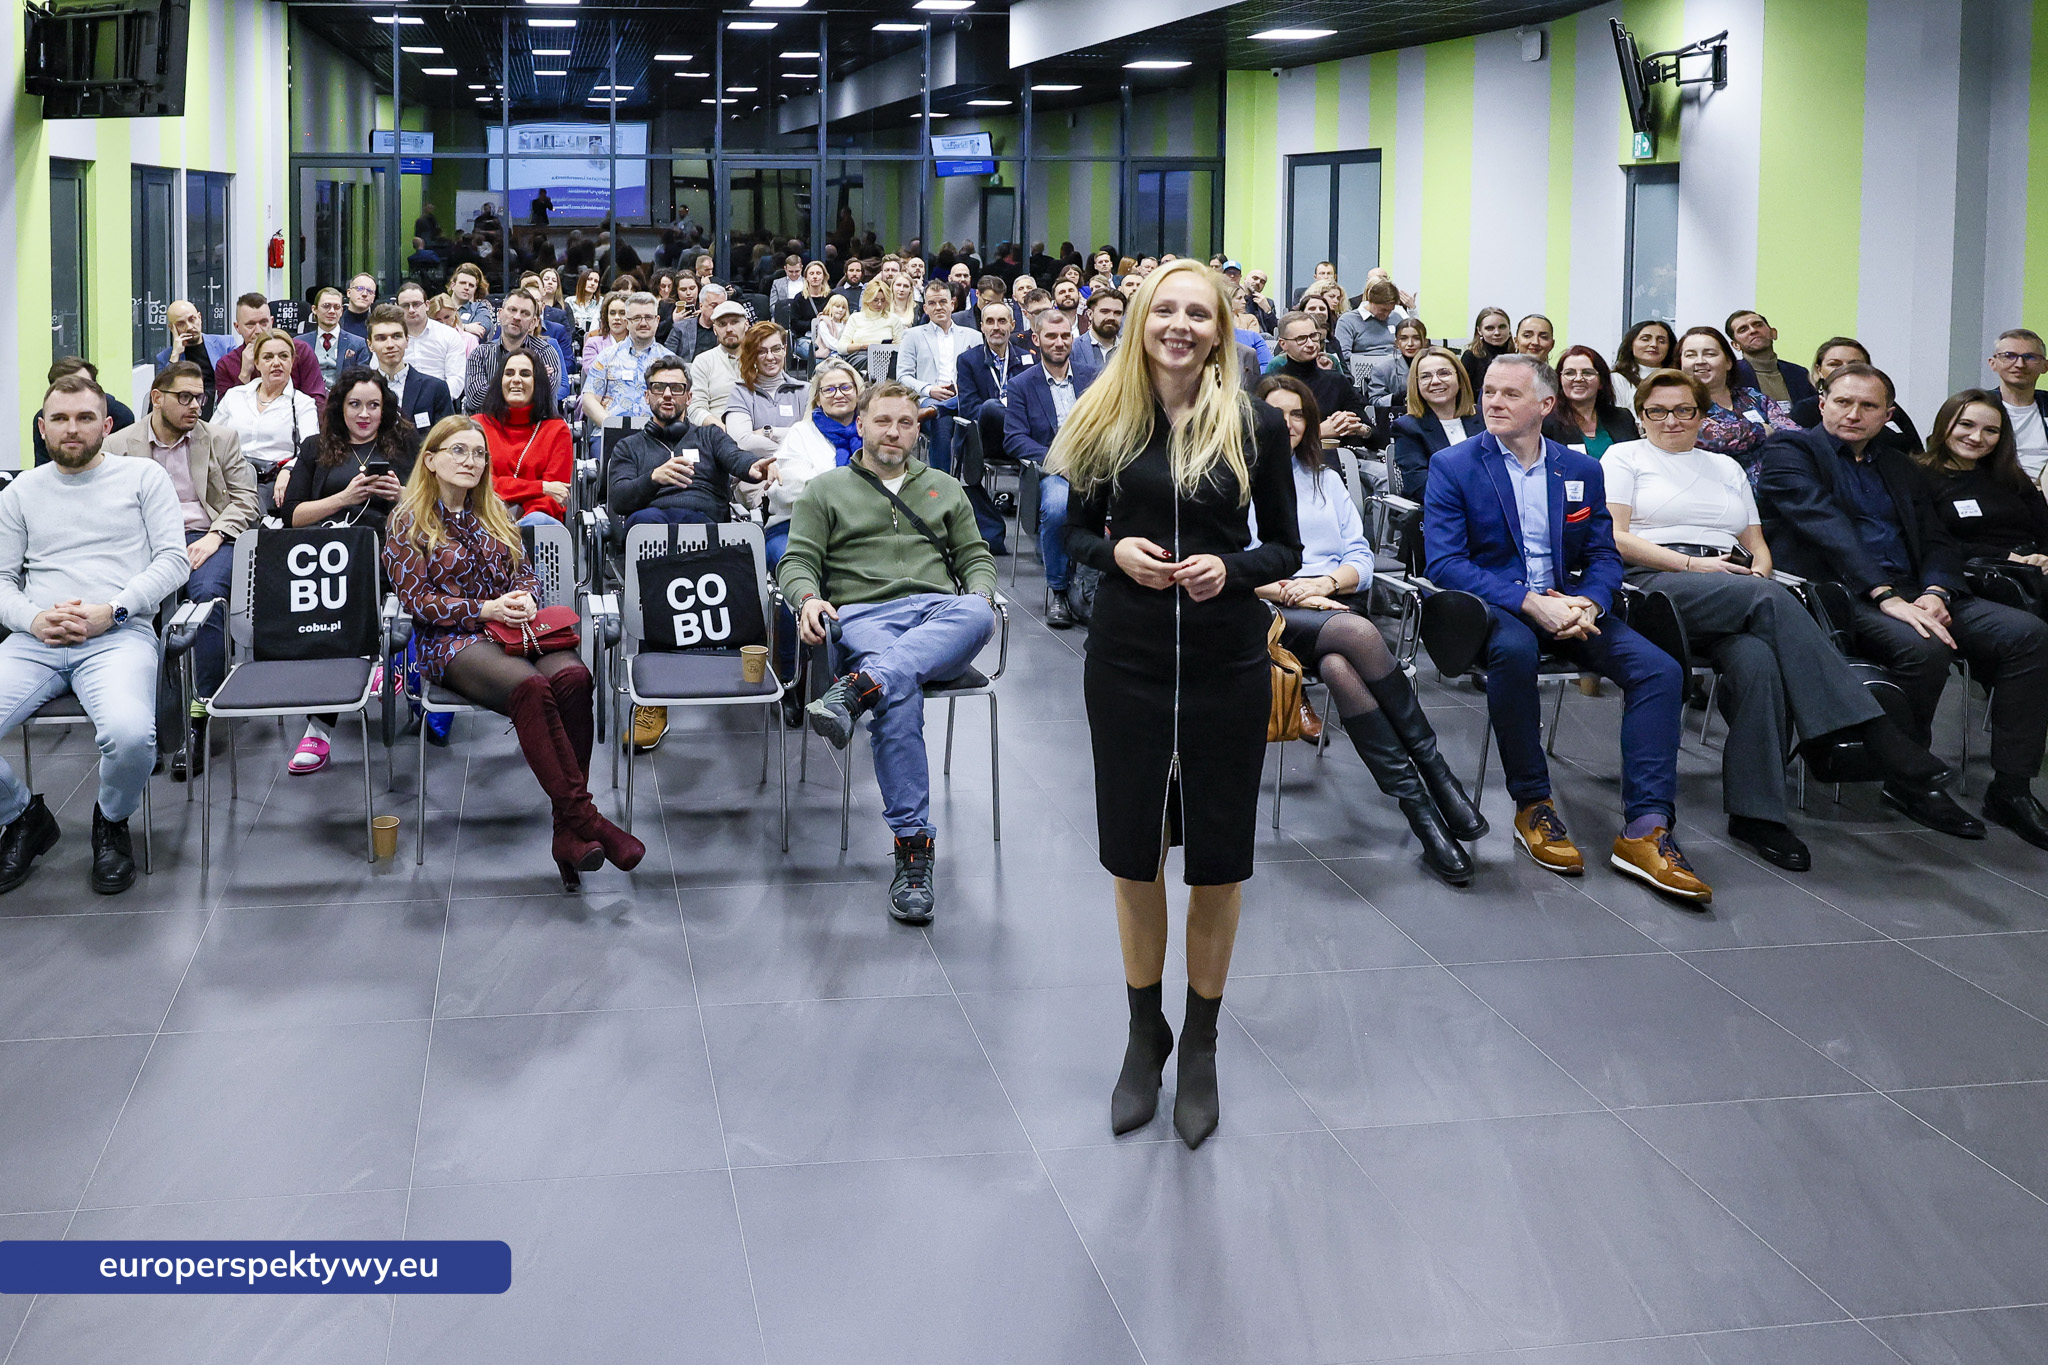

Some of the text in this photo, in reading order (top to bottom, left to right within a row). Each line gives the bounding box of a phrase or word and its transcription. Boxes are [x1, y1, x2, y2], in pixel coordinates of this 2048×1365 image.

[287, 541, 349, 577] CO
[290, 575, 348, 613] BU
[666, 573, 728, 611] CO
[298, 621, 342, 634] cobu.pl
[672, 607, 731, 647] BU
